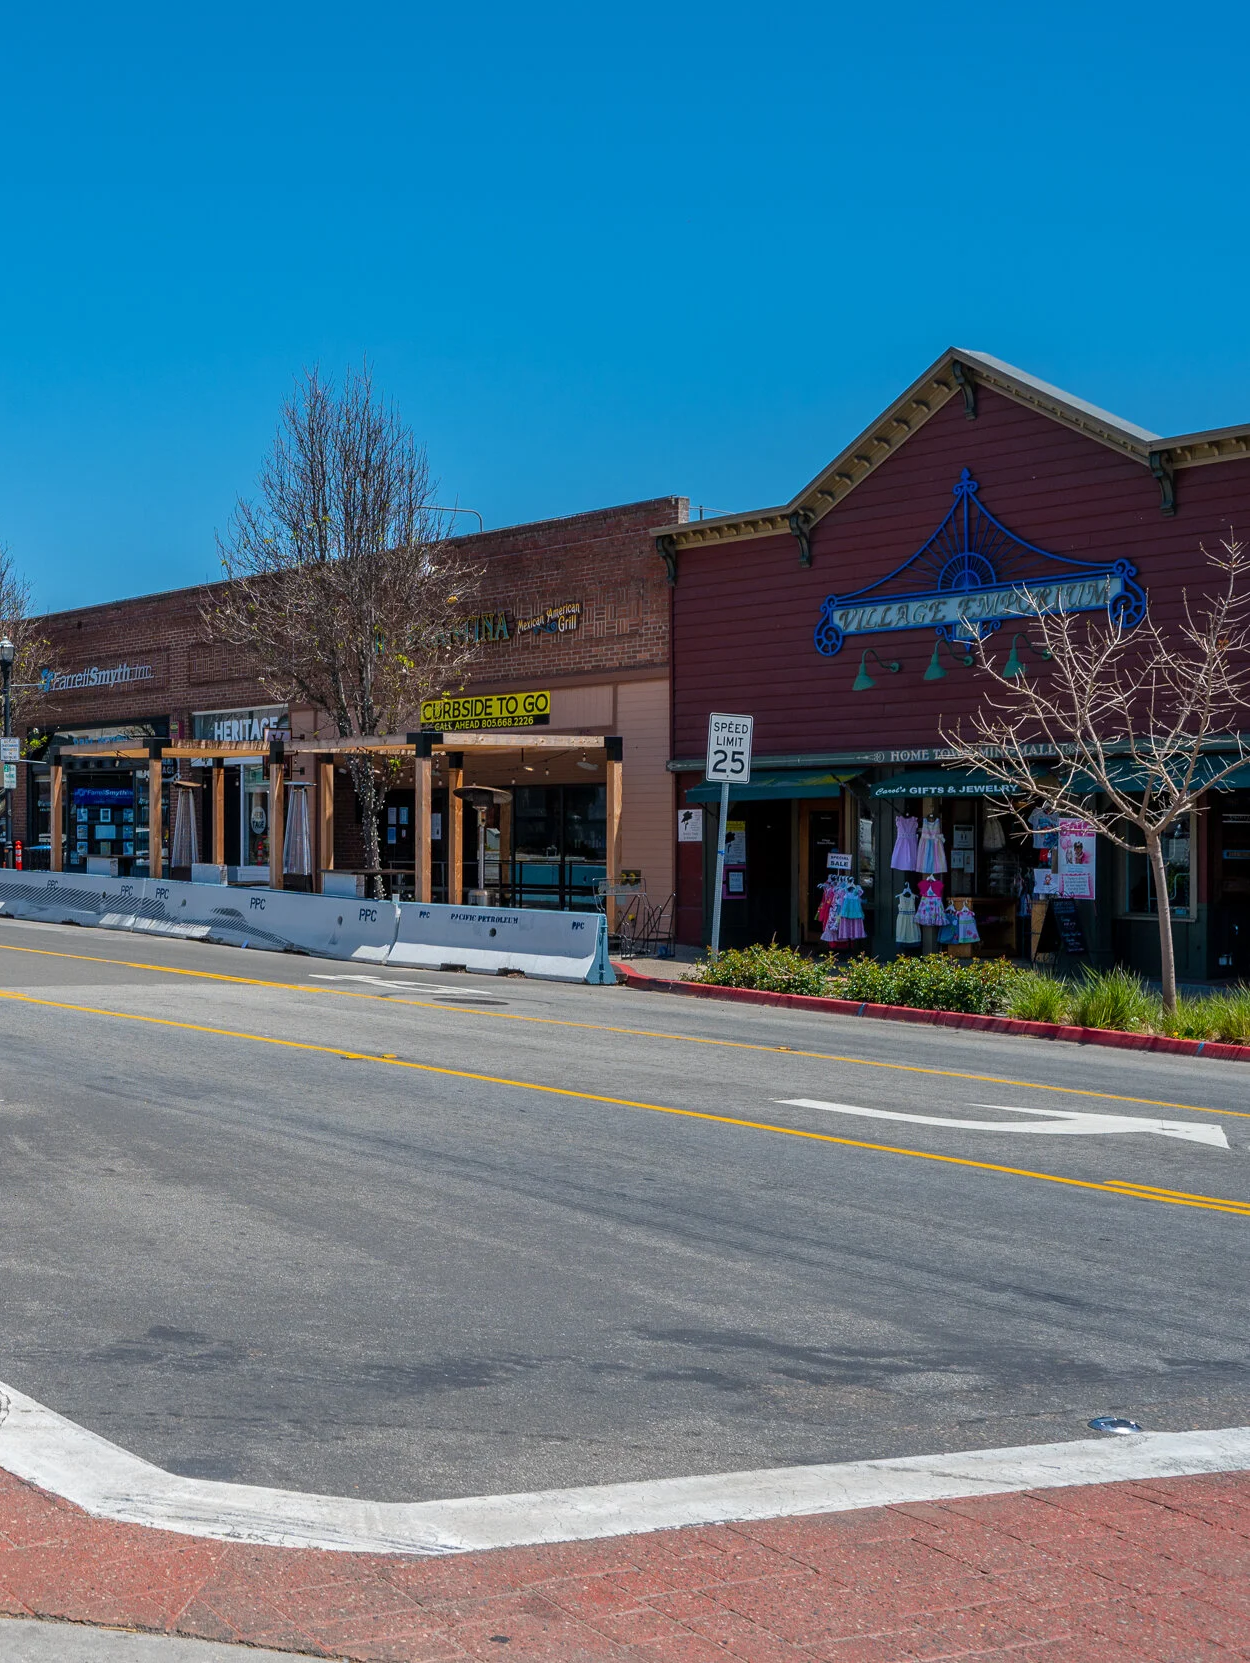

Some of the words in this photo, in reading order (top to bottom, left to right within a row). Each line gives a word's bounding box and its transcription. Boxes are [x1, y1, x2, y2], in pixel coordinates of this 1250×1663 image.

[838, 600, 948, 631] VILLAGE
[958, 582, 1109, 618] EMPORIUM
[517, 615, 545, 634] Mexican
[546, 603, 580, 623] American
[558, 615, 577, 633] Grill
[422, 698, 493, 721] CURBSIDE
[497, 696, 519, 714] TO
[522, 693, 549, 713] GO
[434, 721, 453, 732] CALL
[454, 719, 480, 731] AHEAD
[481, 716, 534, 728] 805.668.2226
[713, 723, 749, 734] SPEED
[716, 735, 744, 748] LIMIT
[712, 749, 745, 774] 25
[890, 749, 930, 762] HOME
[875, 784, 906, 796] Carol's
[909, 786, 945, 795] GIFTS
[947, 785, 956, 794] &
[958, 784, 1019, 793] JEWELRY
[156, 888, 169, 900] PPC
[250, 897, 266, 910] PPC
[358, 908, 378, 922] PPC
[419, 911, 430, 919] PPC
[450, 913, 476, 922] PACIFIC
[478, 915, 519, 924] PETROLEUM
[572, 921, 585, 930] PPC
